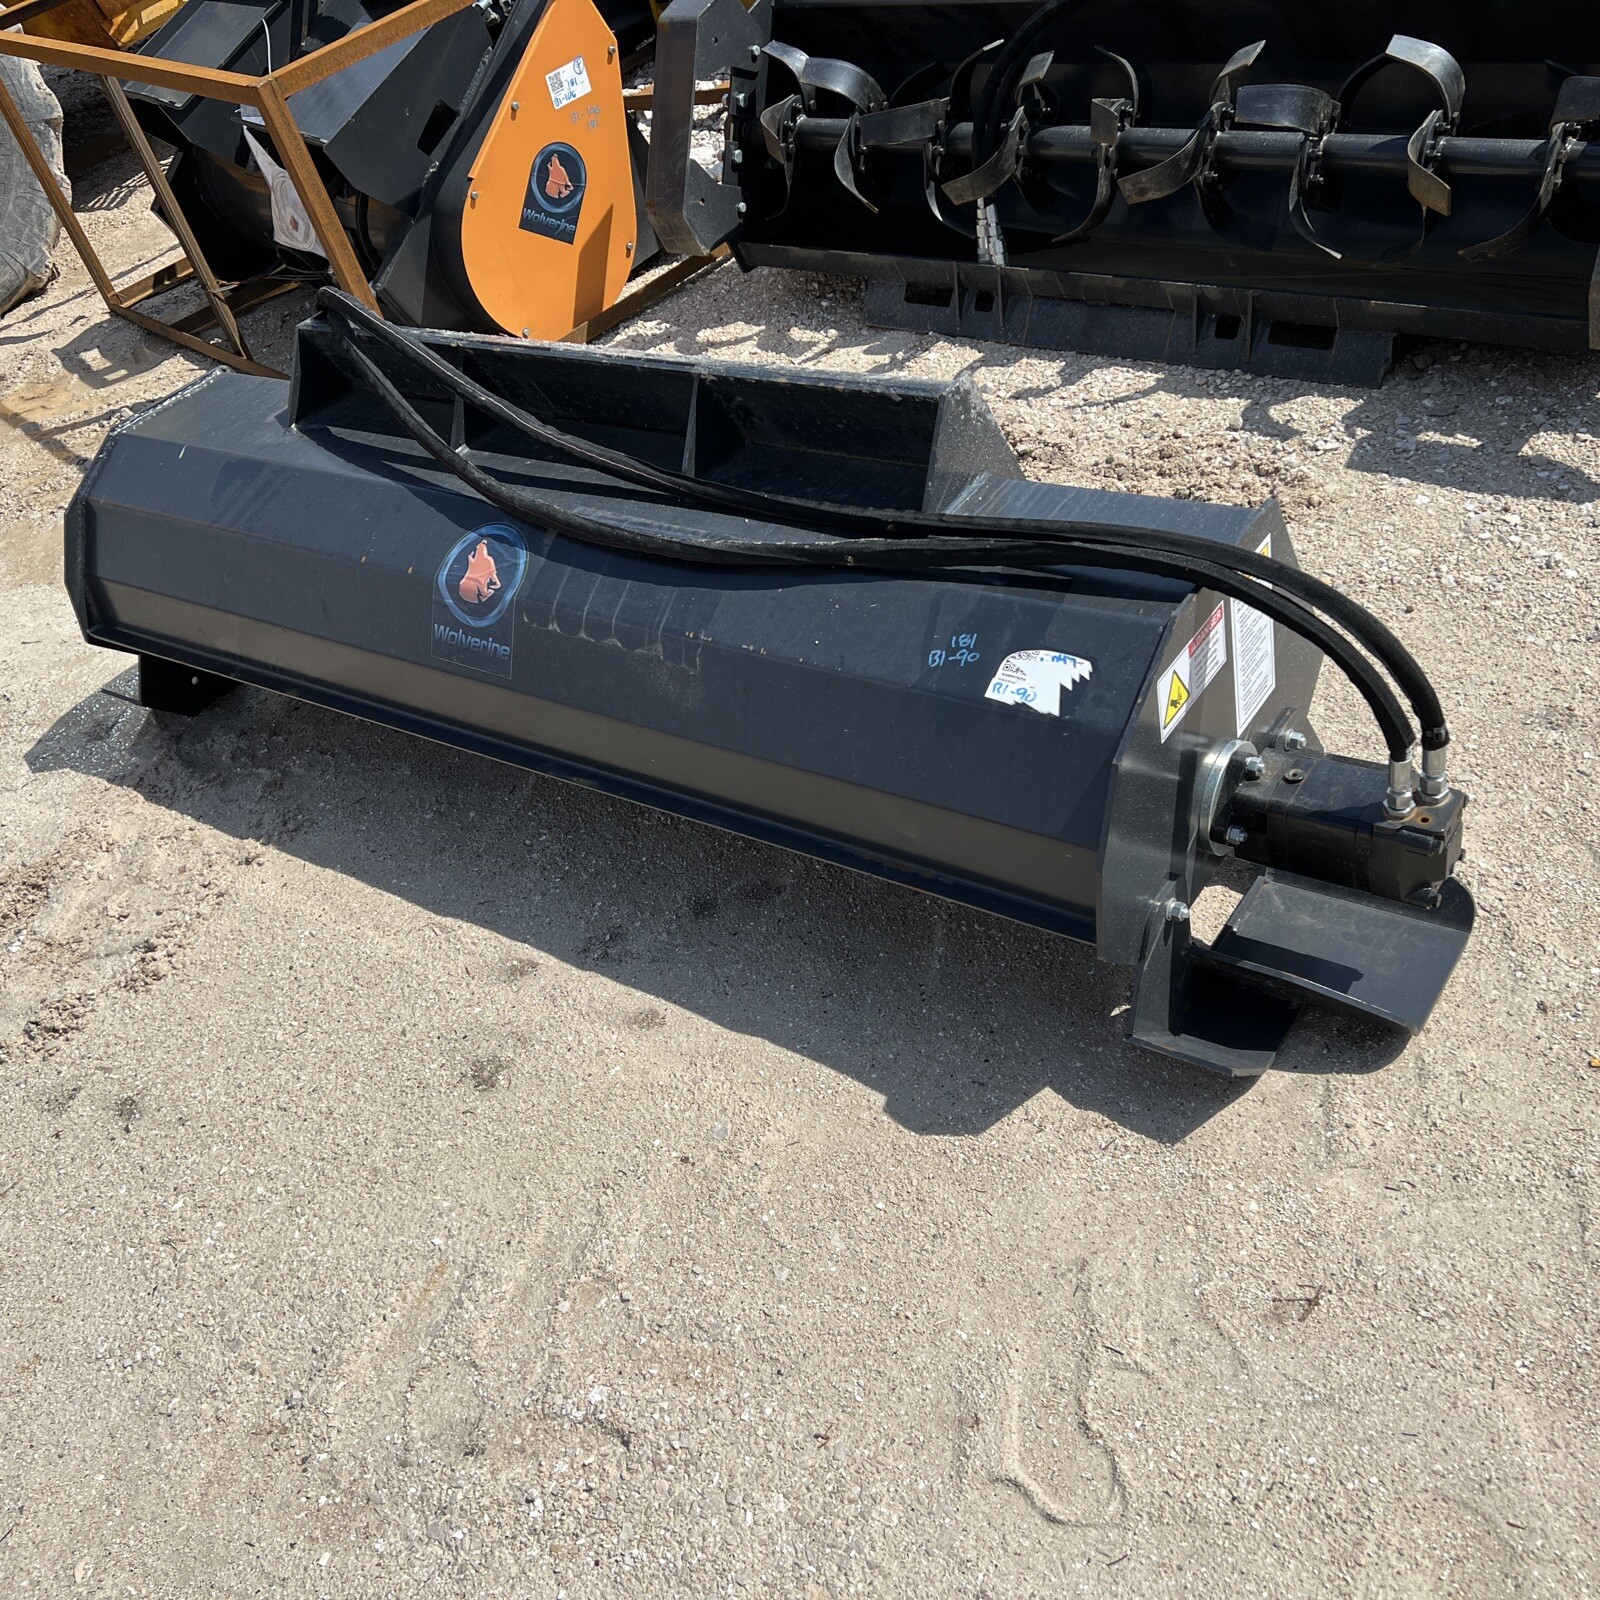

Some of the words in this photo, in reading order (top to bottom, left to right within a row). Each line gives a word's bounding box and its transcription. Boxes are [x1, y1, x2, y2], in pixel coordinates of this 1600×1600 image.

[523, 207, 574, 234] Wolverine
[1196, 609, 1222, 643] DANGER
[434, 623, 510, 660] Wolverine
[951, 633, 977, 649] 181
[928, 648, 981, 668] B1-90
